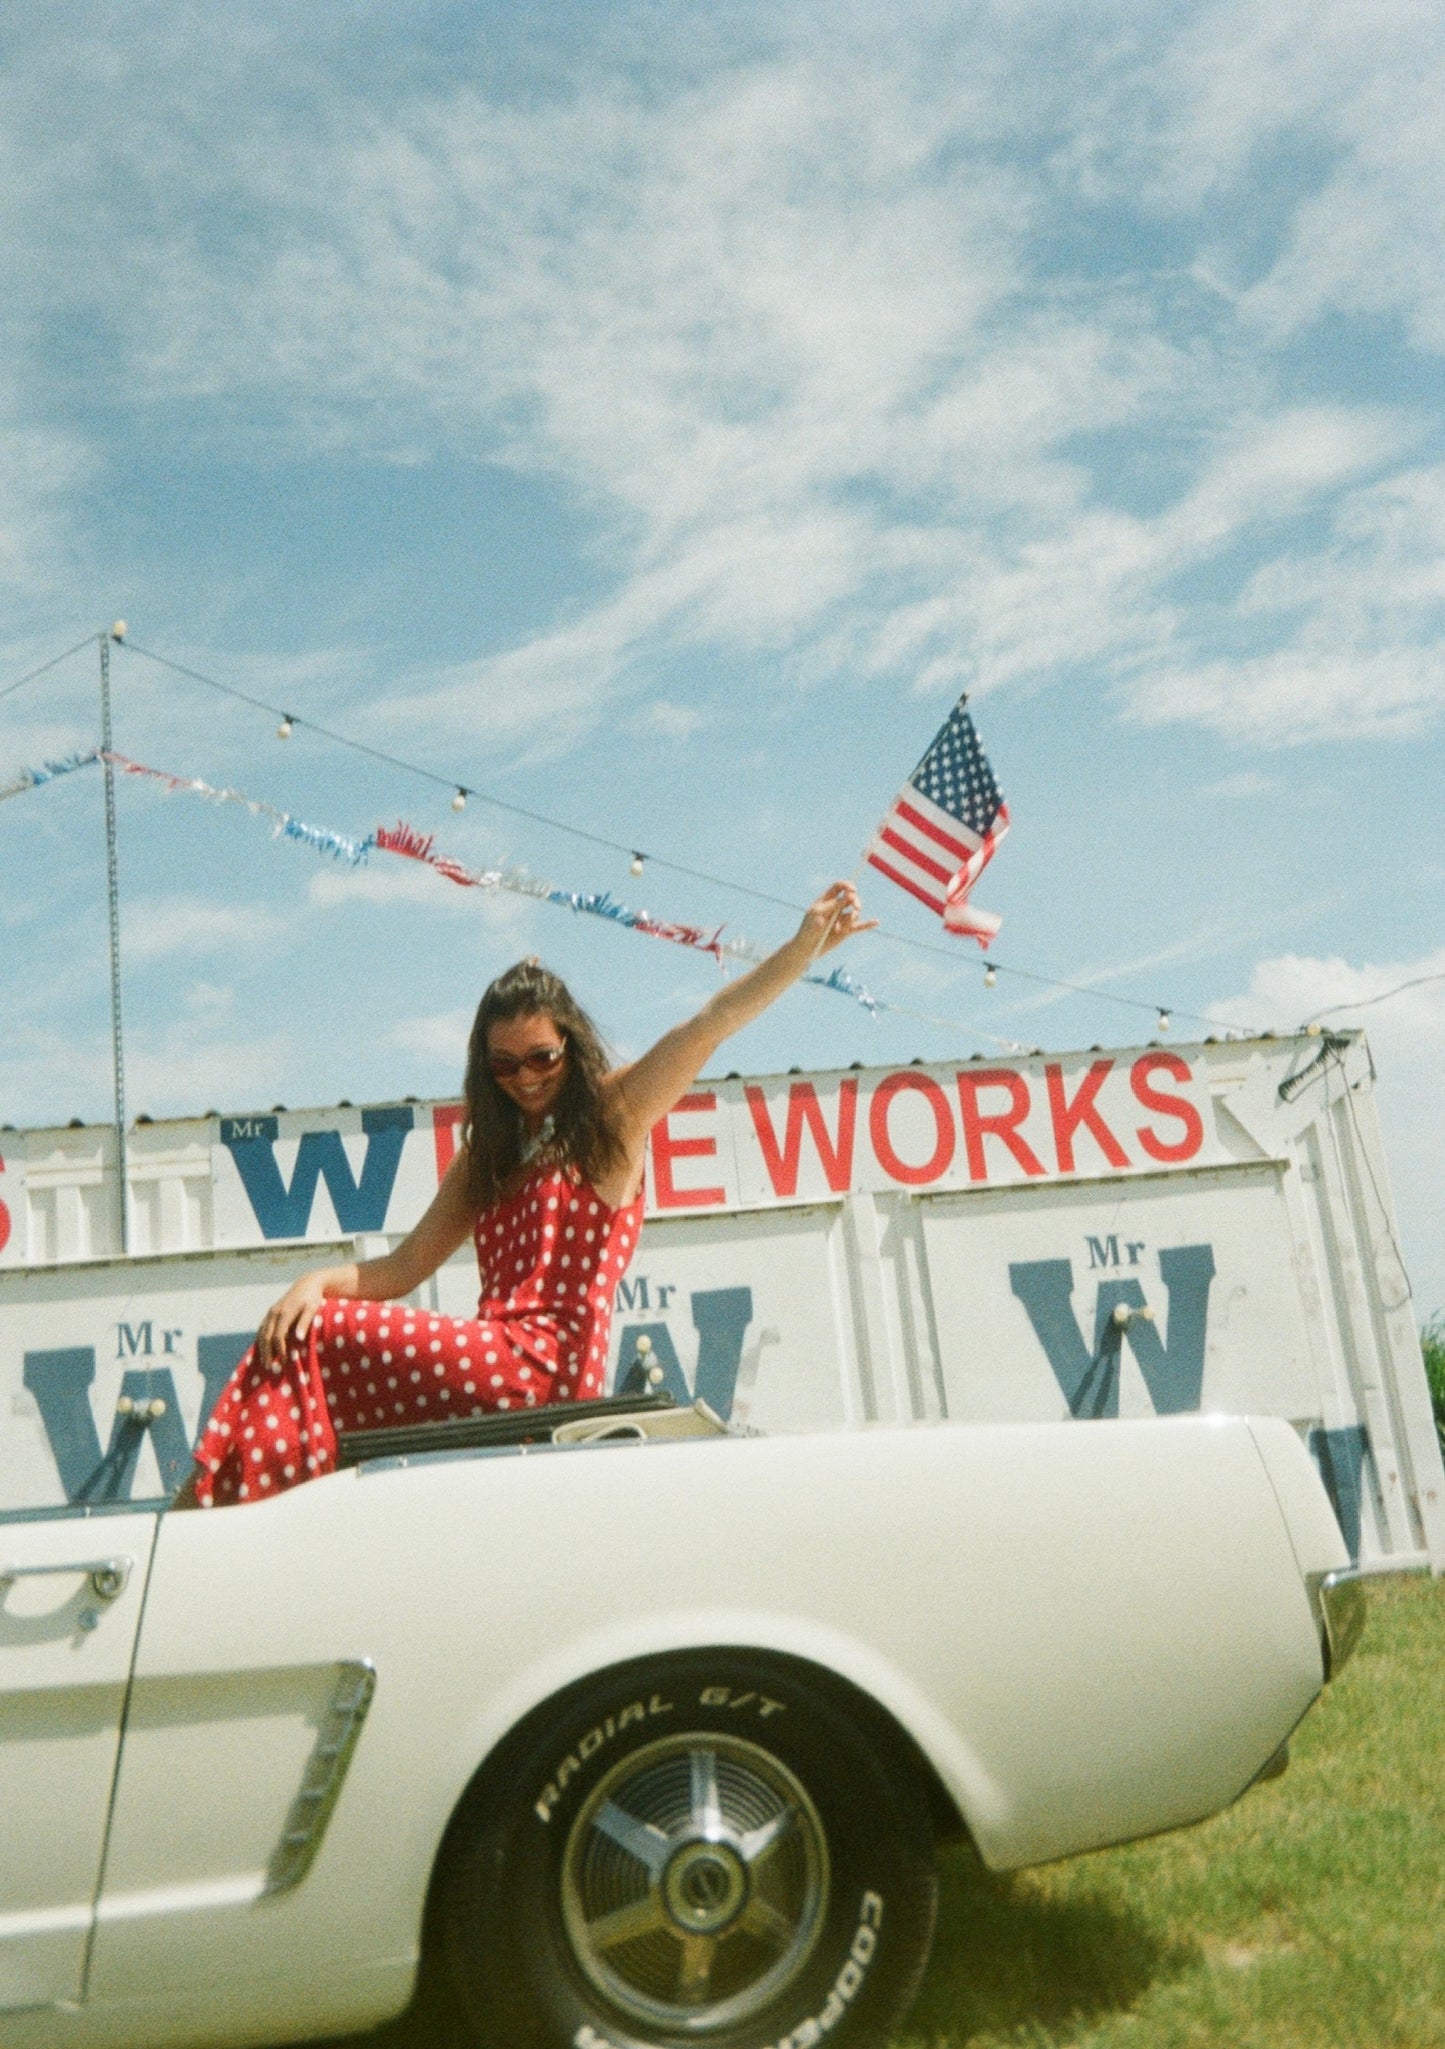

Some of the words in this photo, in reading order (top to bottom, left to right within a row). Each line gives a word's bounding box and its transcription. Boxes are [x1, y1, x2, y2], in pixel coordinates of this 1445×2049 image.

[220, 1107, 414, 1240] W
[433, 1051, 1204, 1210] EWORKS
[232, 1120, 264, 1138] Mr
[616, 1275, 676, 1312] Mr
[1085, 1234, 1146, 1269] Mr
[116, 1321, 183, 1358] Mr
[1009, 1244, 1216, 1420] W
[23, 1330, 260, 1504] W
[535, 1694, 674, 1822] RADIAL
[700, 1687, 786, 1717] G/T
[763, 1890, 883, 2049] COOP
